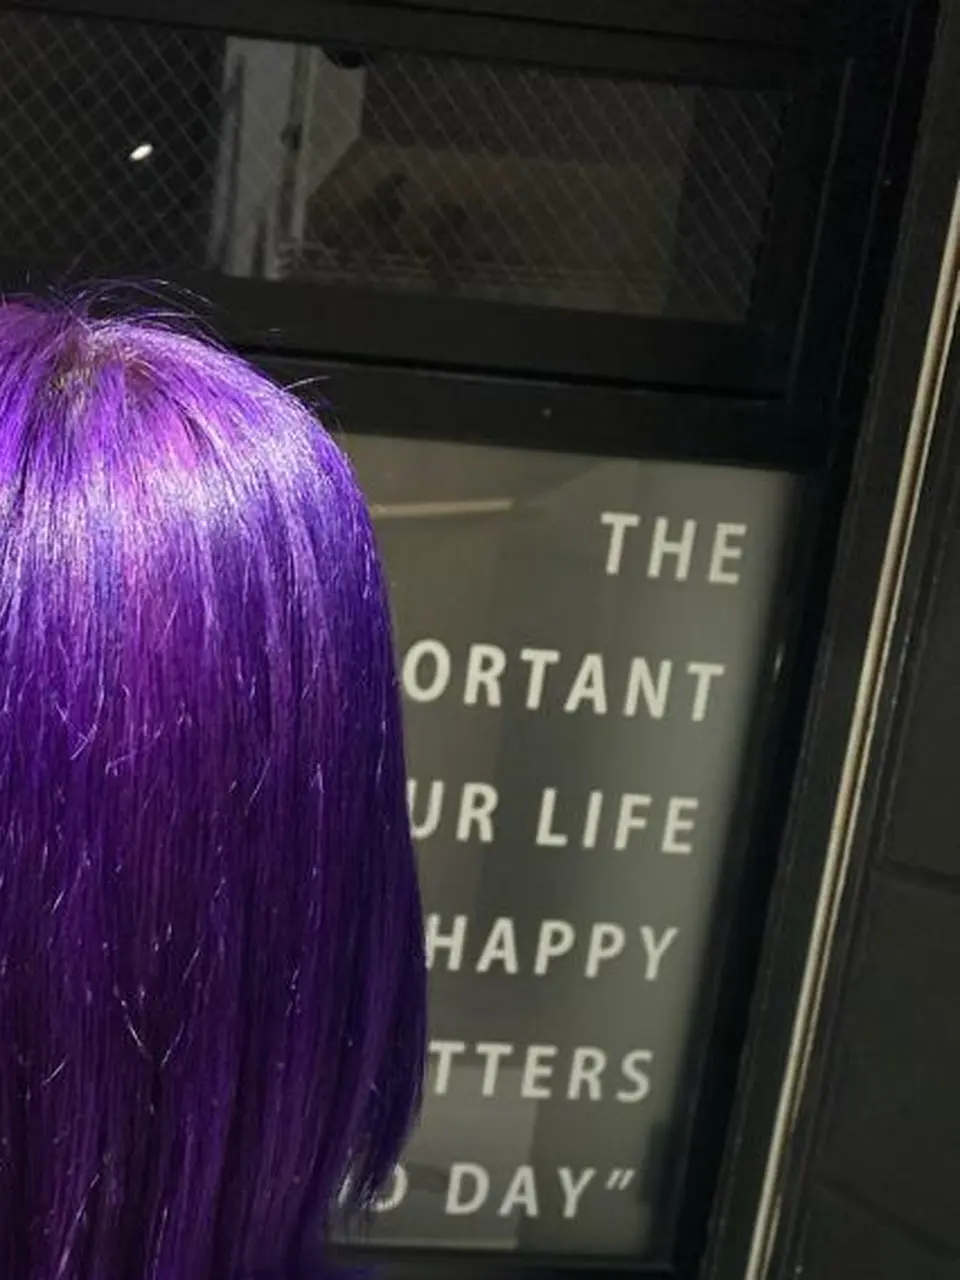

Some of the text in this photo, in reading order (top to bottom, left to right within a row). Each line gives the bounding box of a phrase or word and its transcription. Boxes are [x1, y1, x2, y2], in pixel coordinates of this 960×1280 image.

[601, 511, 747, 585] THE
[402, 638, 728, 722] ORTANT
[535, 787, 700, 855] LIFE
[424, 913, 680, 982] HAPPY
[428, 1039, 655, 1104] TTERS
